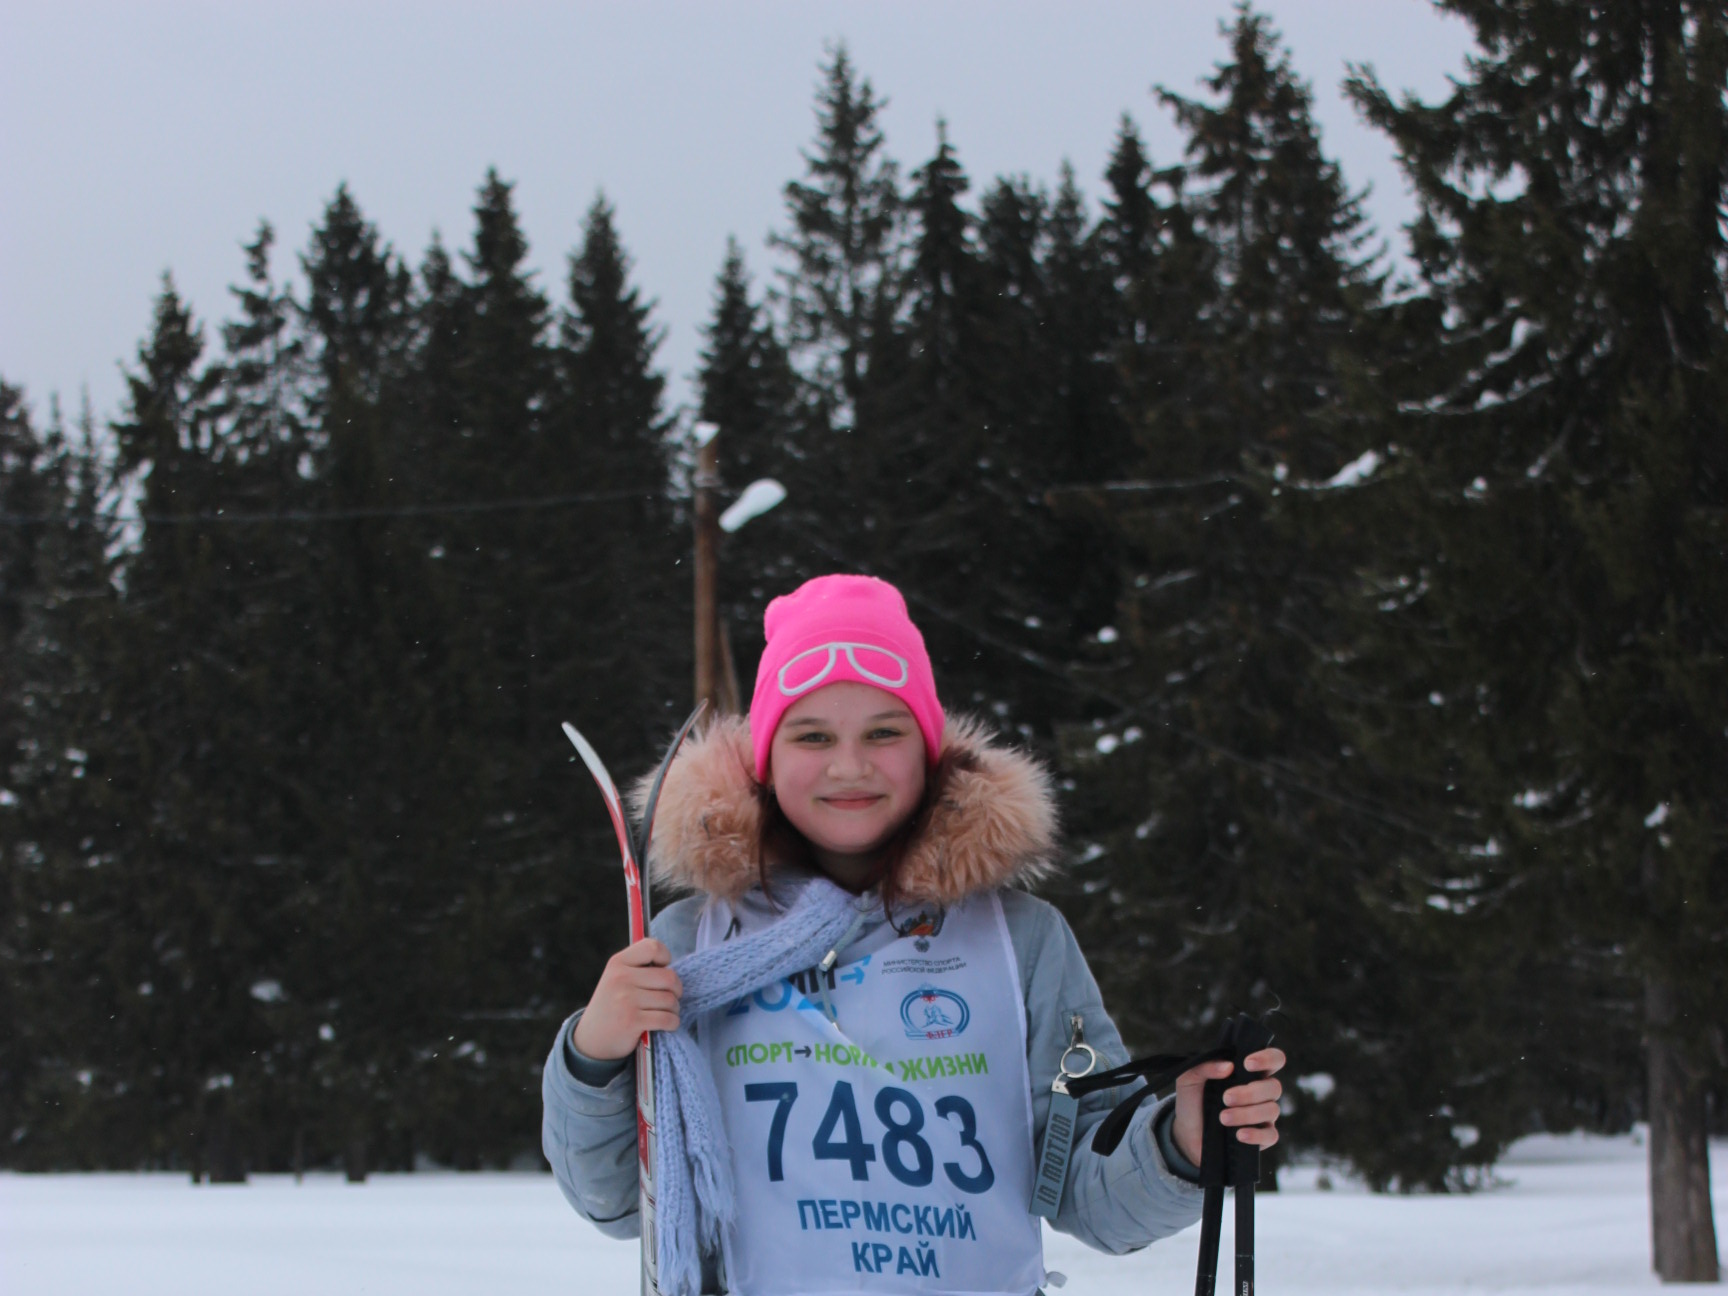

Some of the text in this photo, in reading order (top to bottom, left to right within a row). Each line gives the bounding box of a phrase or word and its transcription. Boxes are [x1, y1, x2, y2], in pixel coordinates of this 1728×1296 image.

[726, 1042, 793, 1067] СПОРТ
[898, 1053, 989, 1082] ЖИЗНИ
[744, 1080, 995, 1194] 7483
[797, 1200, 977, 1241] ПЕРМСКИЙ
[851, 1241, 941, 1278] КРАЙ
